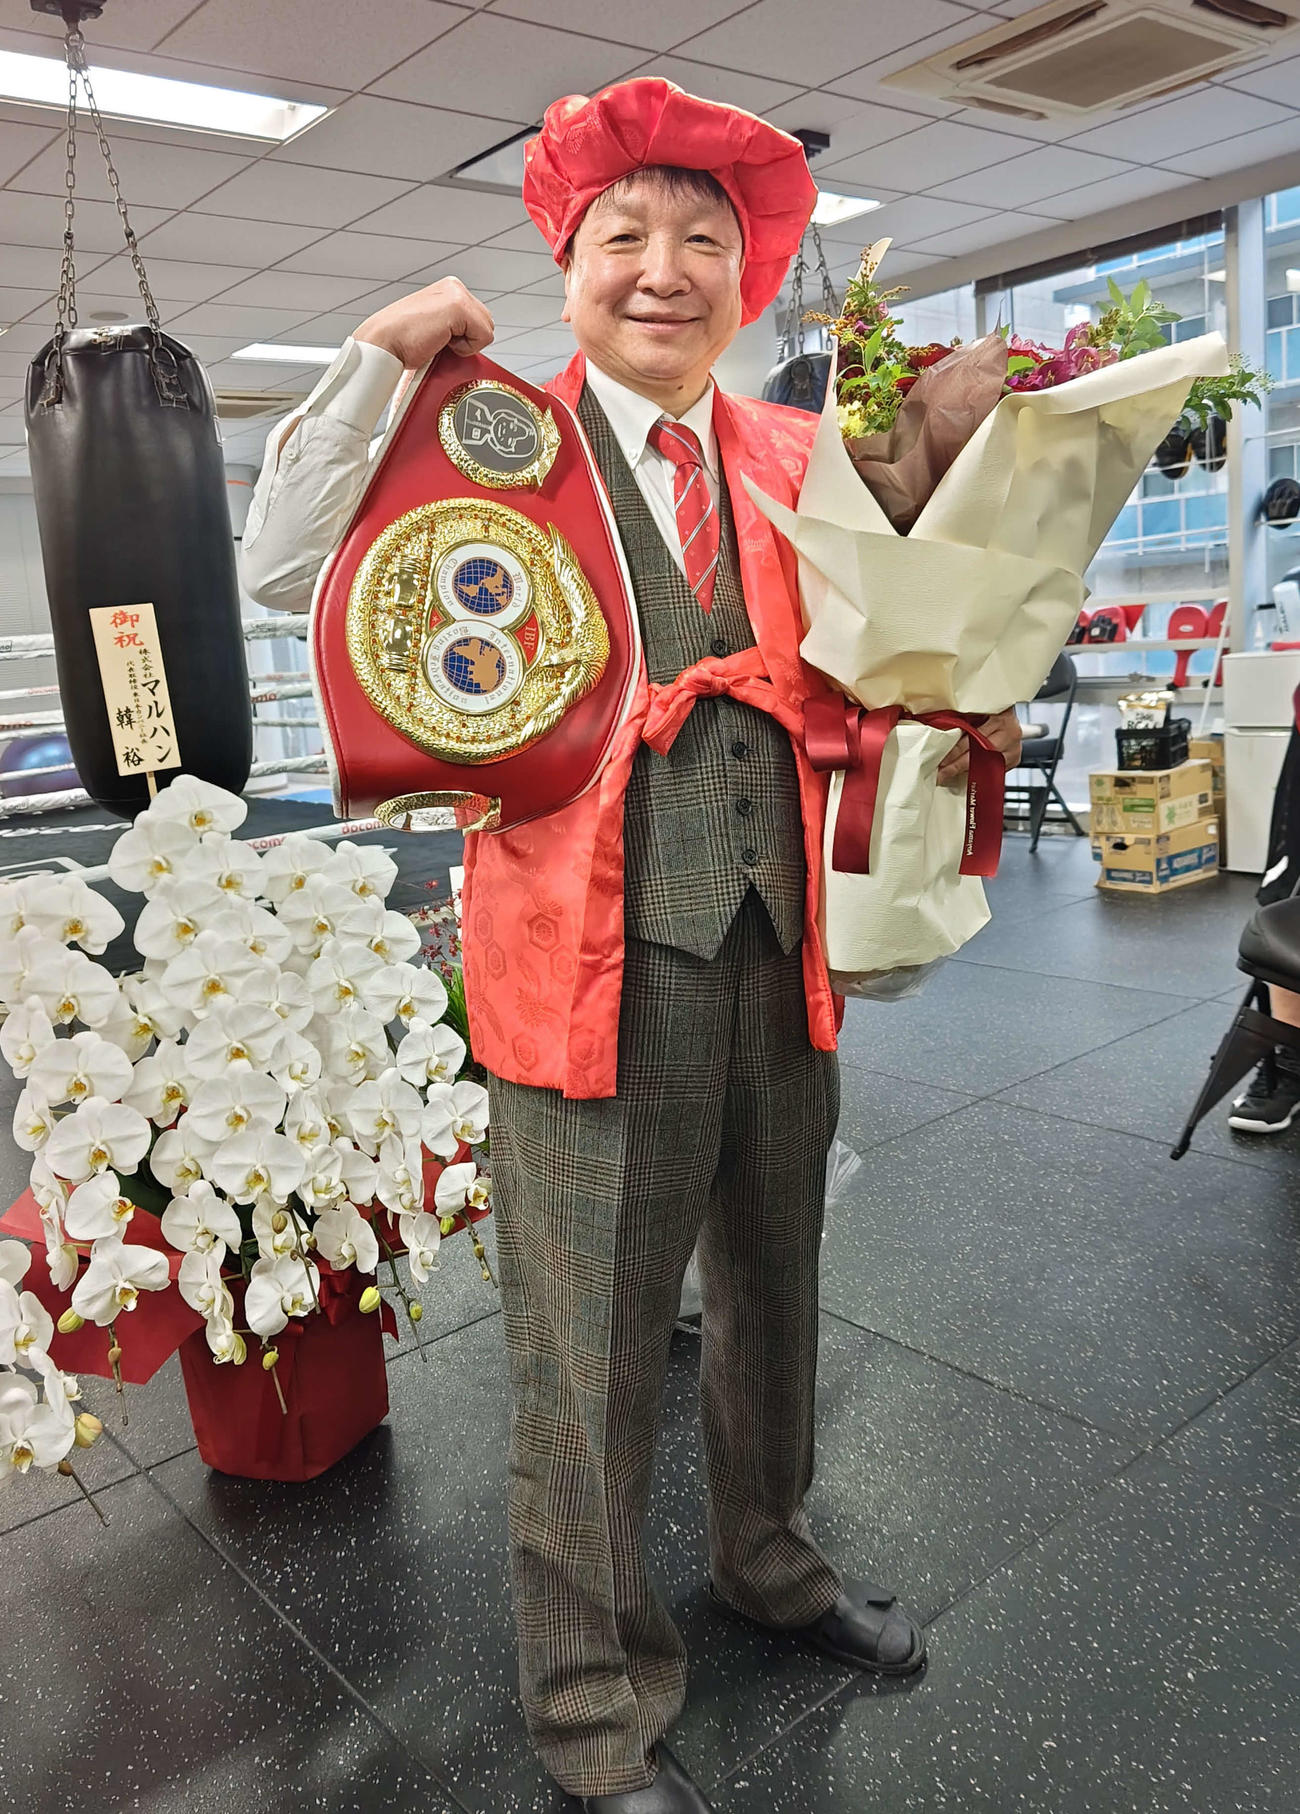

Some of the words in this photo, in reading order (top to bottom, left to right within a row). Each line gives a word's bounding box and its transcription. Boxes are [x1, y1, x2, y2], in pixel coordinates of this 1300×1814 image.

[110, 610, 144, 648] 御祝
[522, 626, 537, 650] IBF
[341, 820, 386, 835] docom
